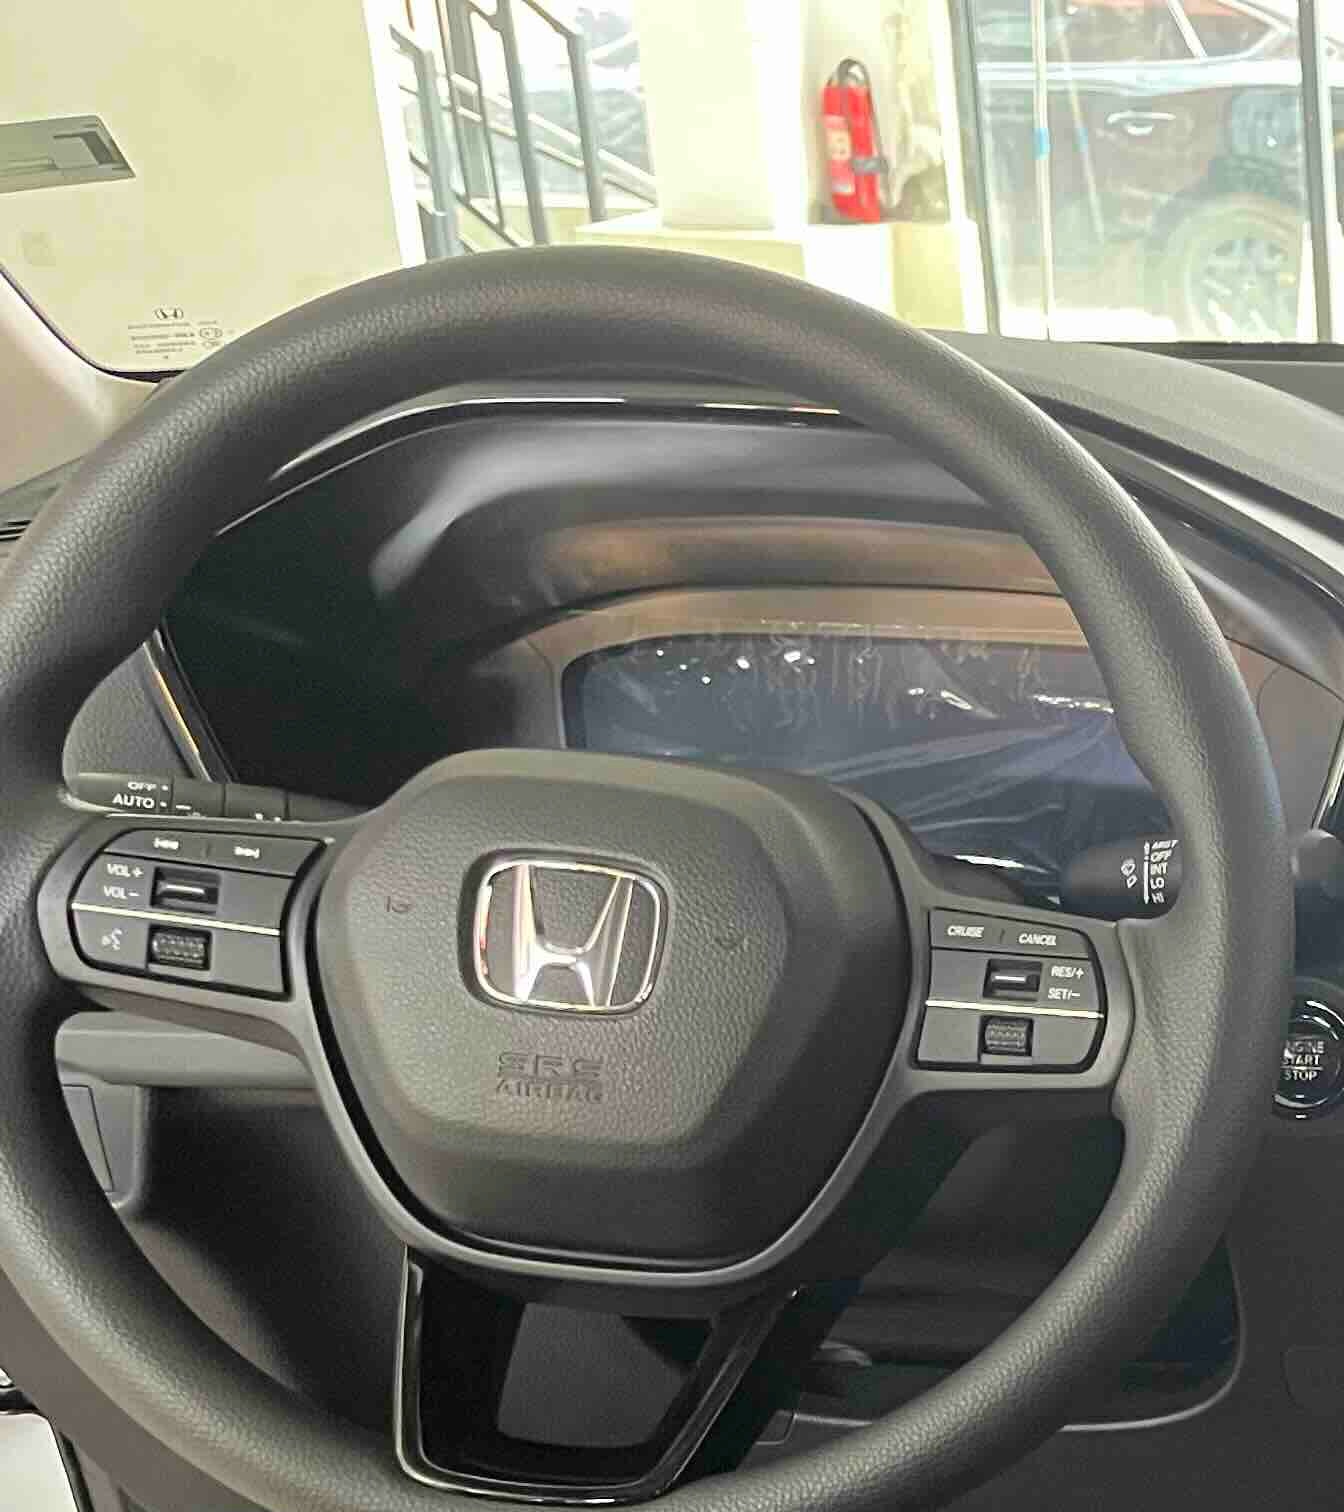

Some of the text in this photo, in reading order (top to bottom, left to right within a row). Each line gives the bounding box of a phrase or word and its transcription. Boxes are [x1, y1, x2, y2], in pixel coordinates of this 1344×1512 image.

[112, 793, 155, 809] AUTO
[1150, 862, 1168, 875] INT
[1149, 877, 1165, 890] LO
[1151, 891, 1165, 904] HI
[947, 925, 985, 938] CRUISE
[1018, 933, 1057, 946] CANCEL
[498, 1051, 602, 1079] SRS
[1281, 1070, 1318, 1081] STOP
